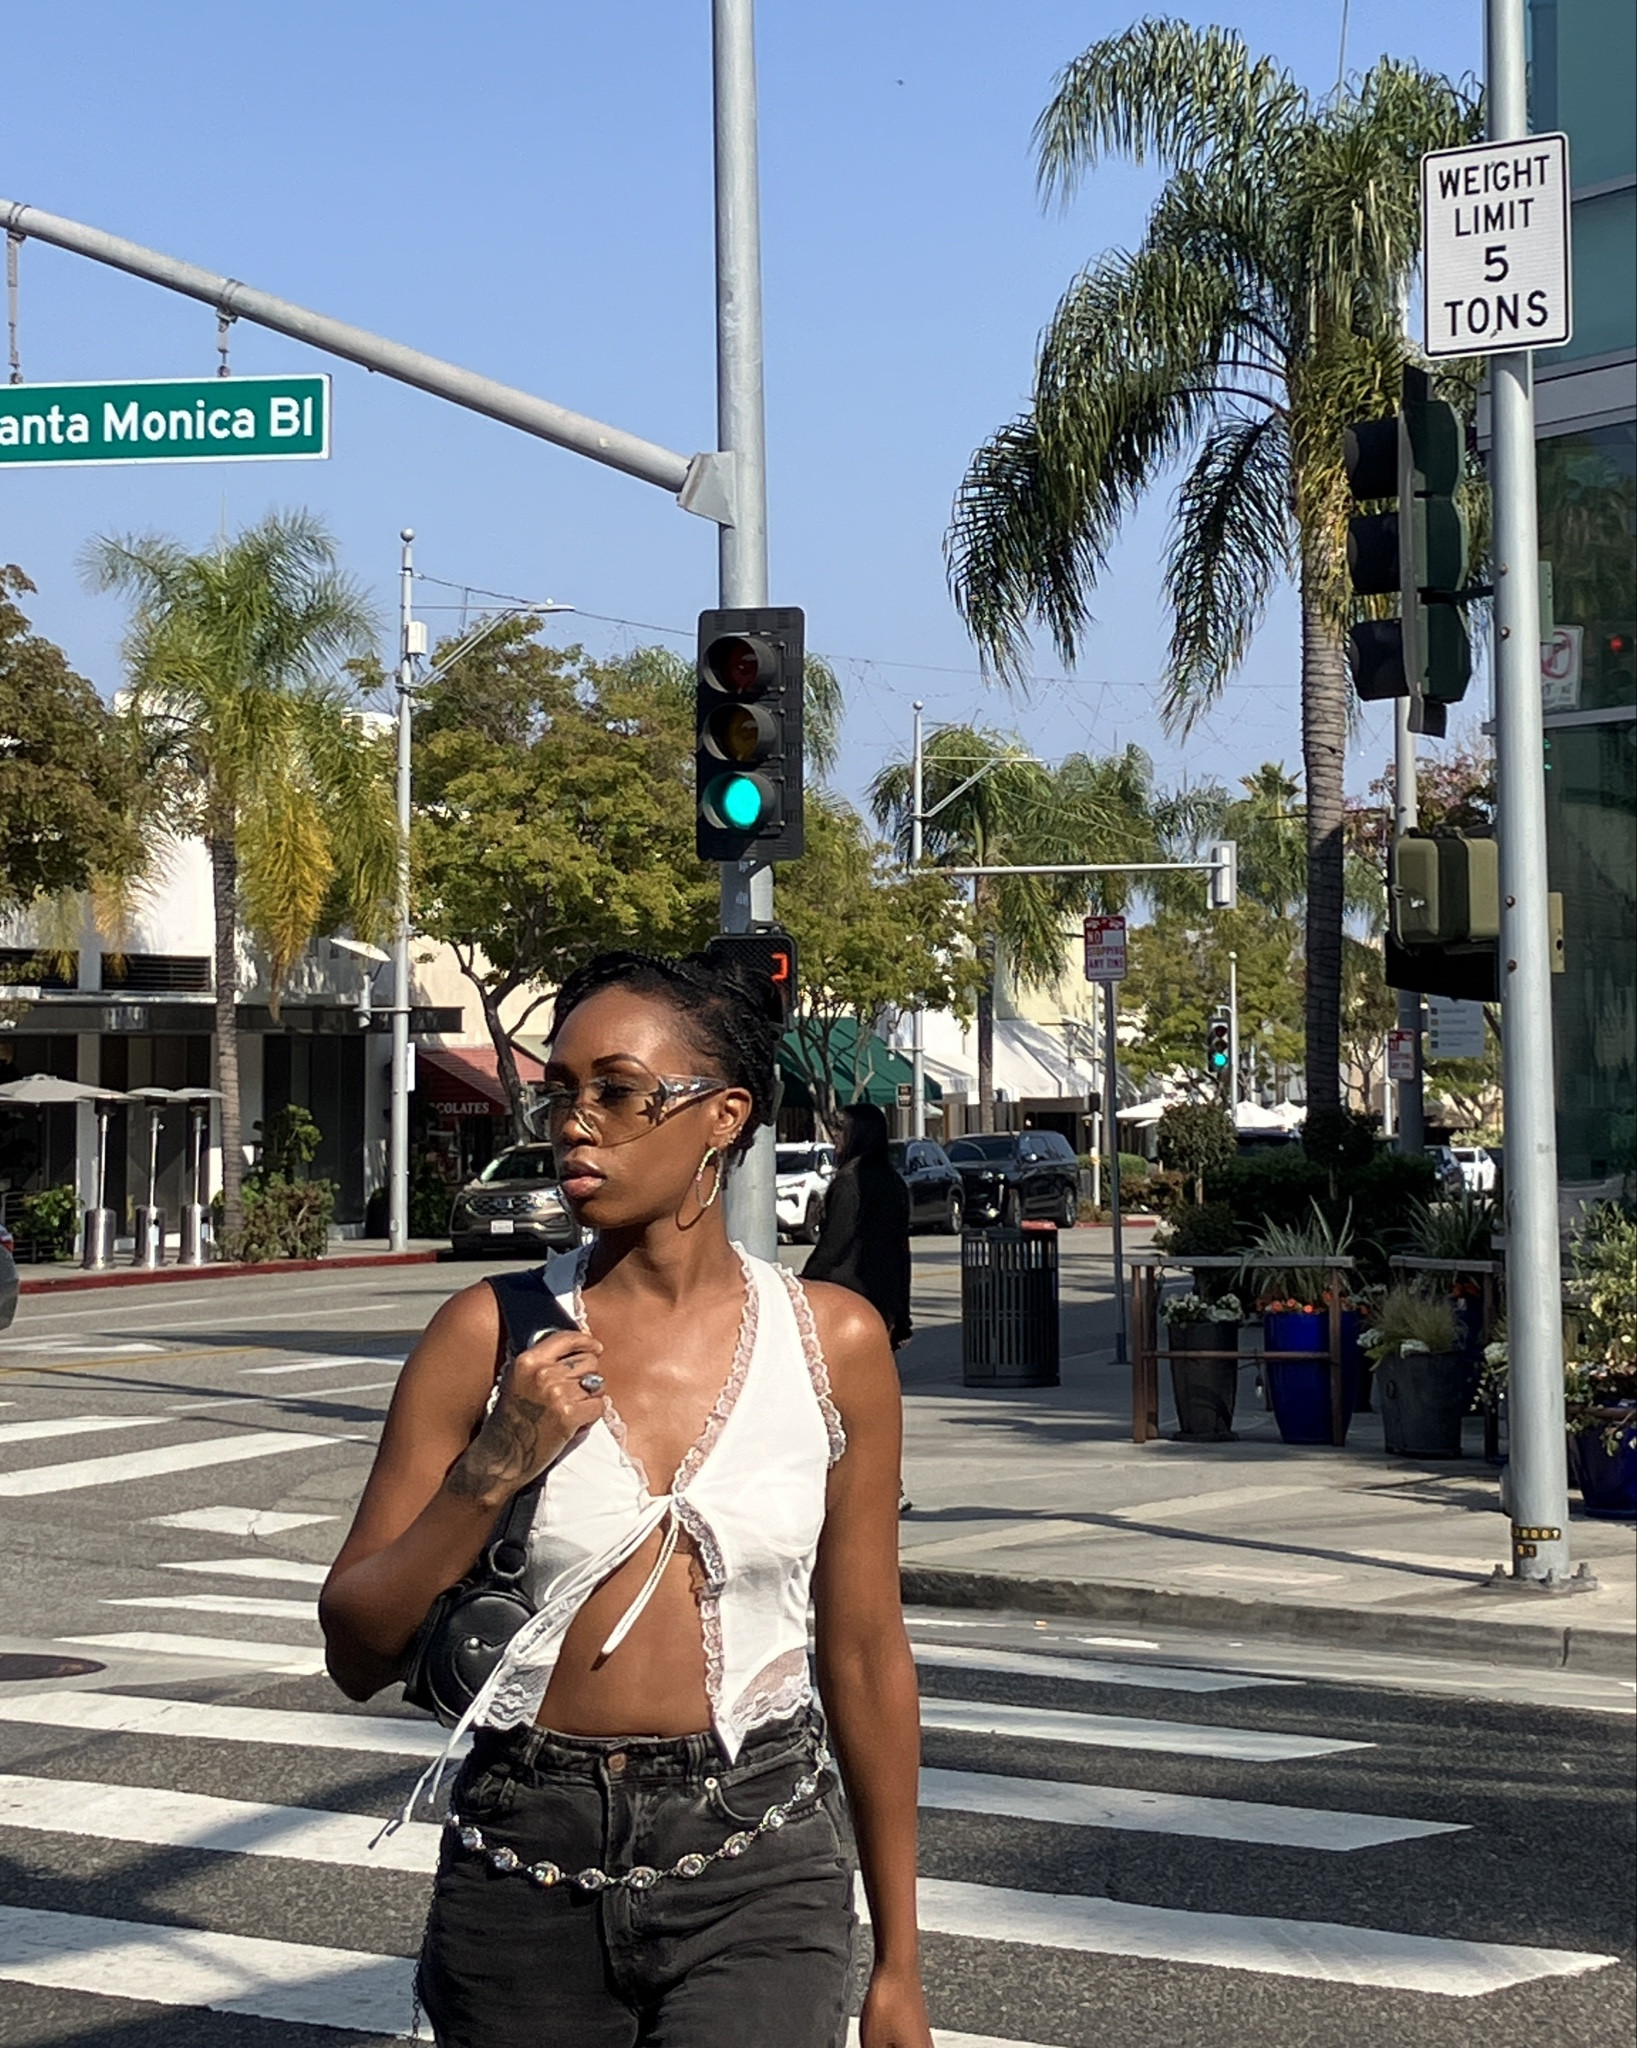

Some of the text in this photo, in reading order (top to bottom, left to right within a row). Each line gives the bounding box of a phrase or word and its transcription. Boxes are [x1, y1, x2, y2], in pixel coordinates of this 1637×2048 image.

[1438, 154, 1550, 200] WEIGHT
[1455, 197, 1535, 237] LIMIT
[1484, 244, 1509, 283] 5
[1444, 289, 1548, 337] TONS
[103, 399, 255, 442] Monica
[269, 396, 313, 437] Bl
[1087, 930, 1101, 944] NO
[429, 1101, 490, 1115] COLATES
